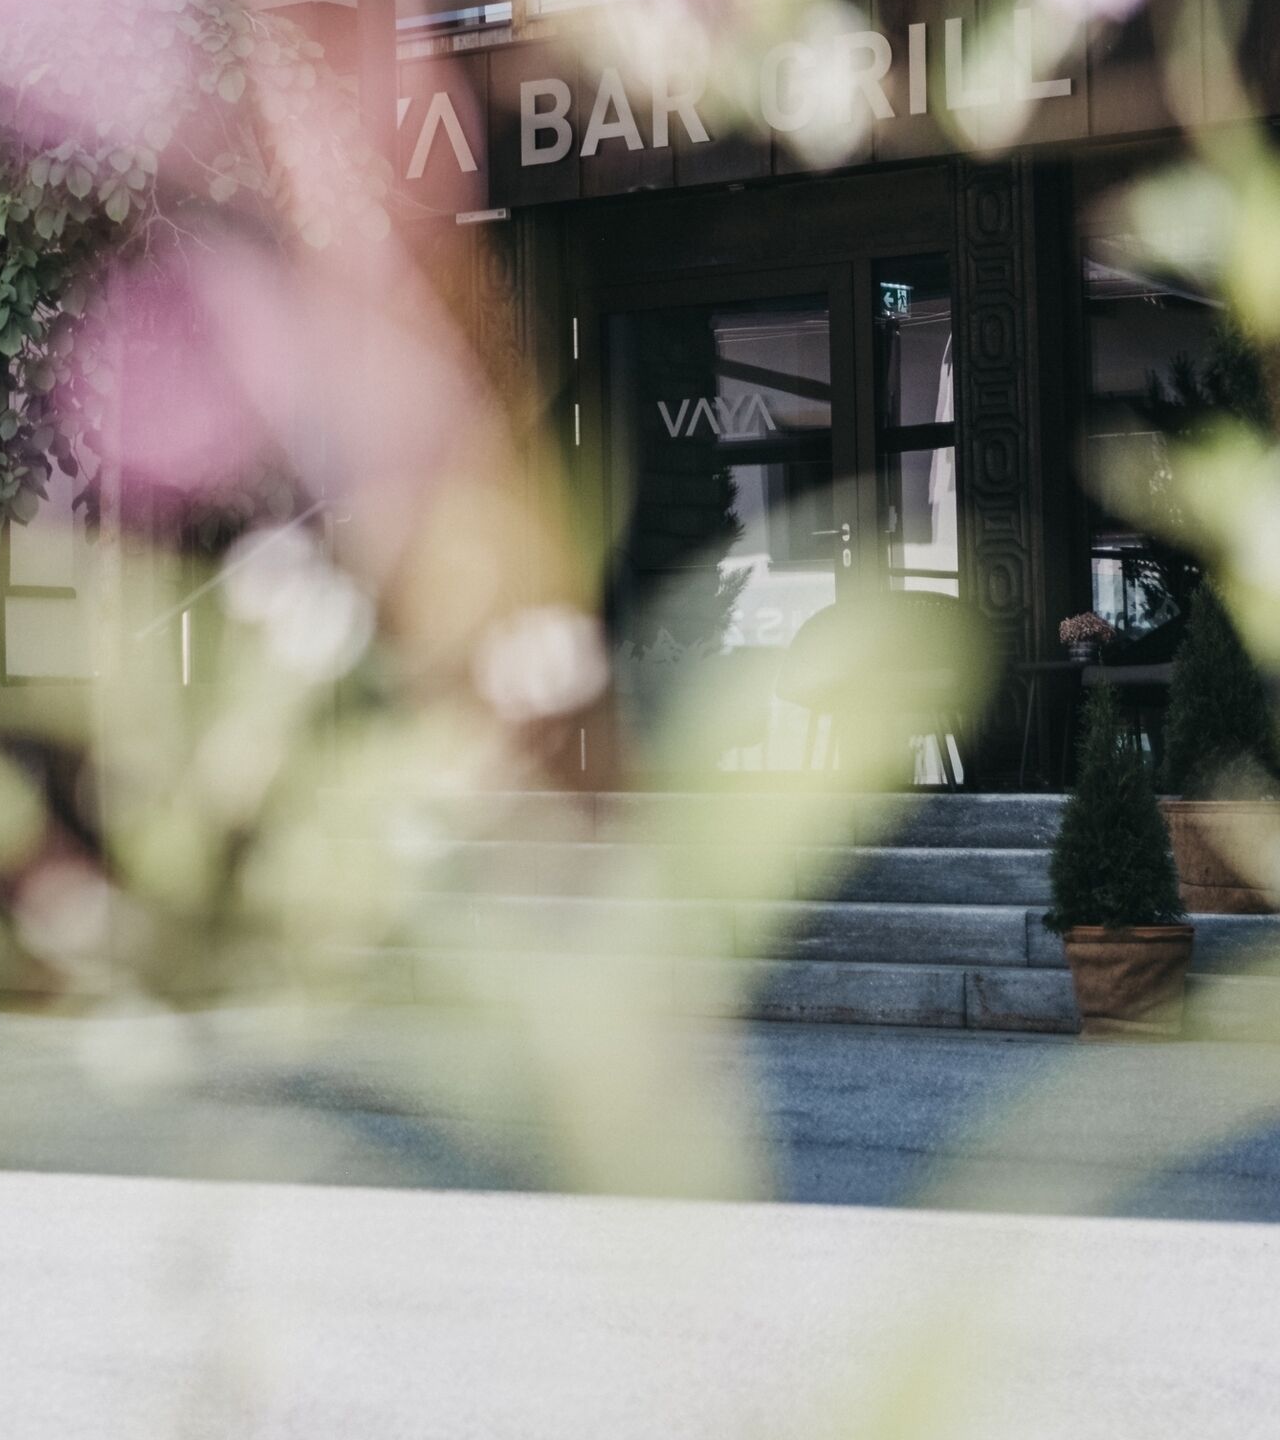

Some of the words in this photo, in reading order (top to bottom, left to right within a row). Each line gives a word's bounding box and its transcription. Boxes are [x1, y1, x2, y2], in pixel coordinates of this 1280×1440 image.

[520, 54, 710, 167] BAR
[759, 8, 1072, 132] GRILL
[657, 393, 776, 437] VAYA
